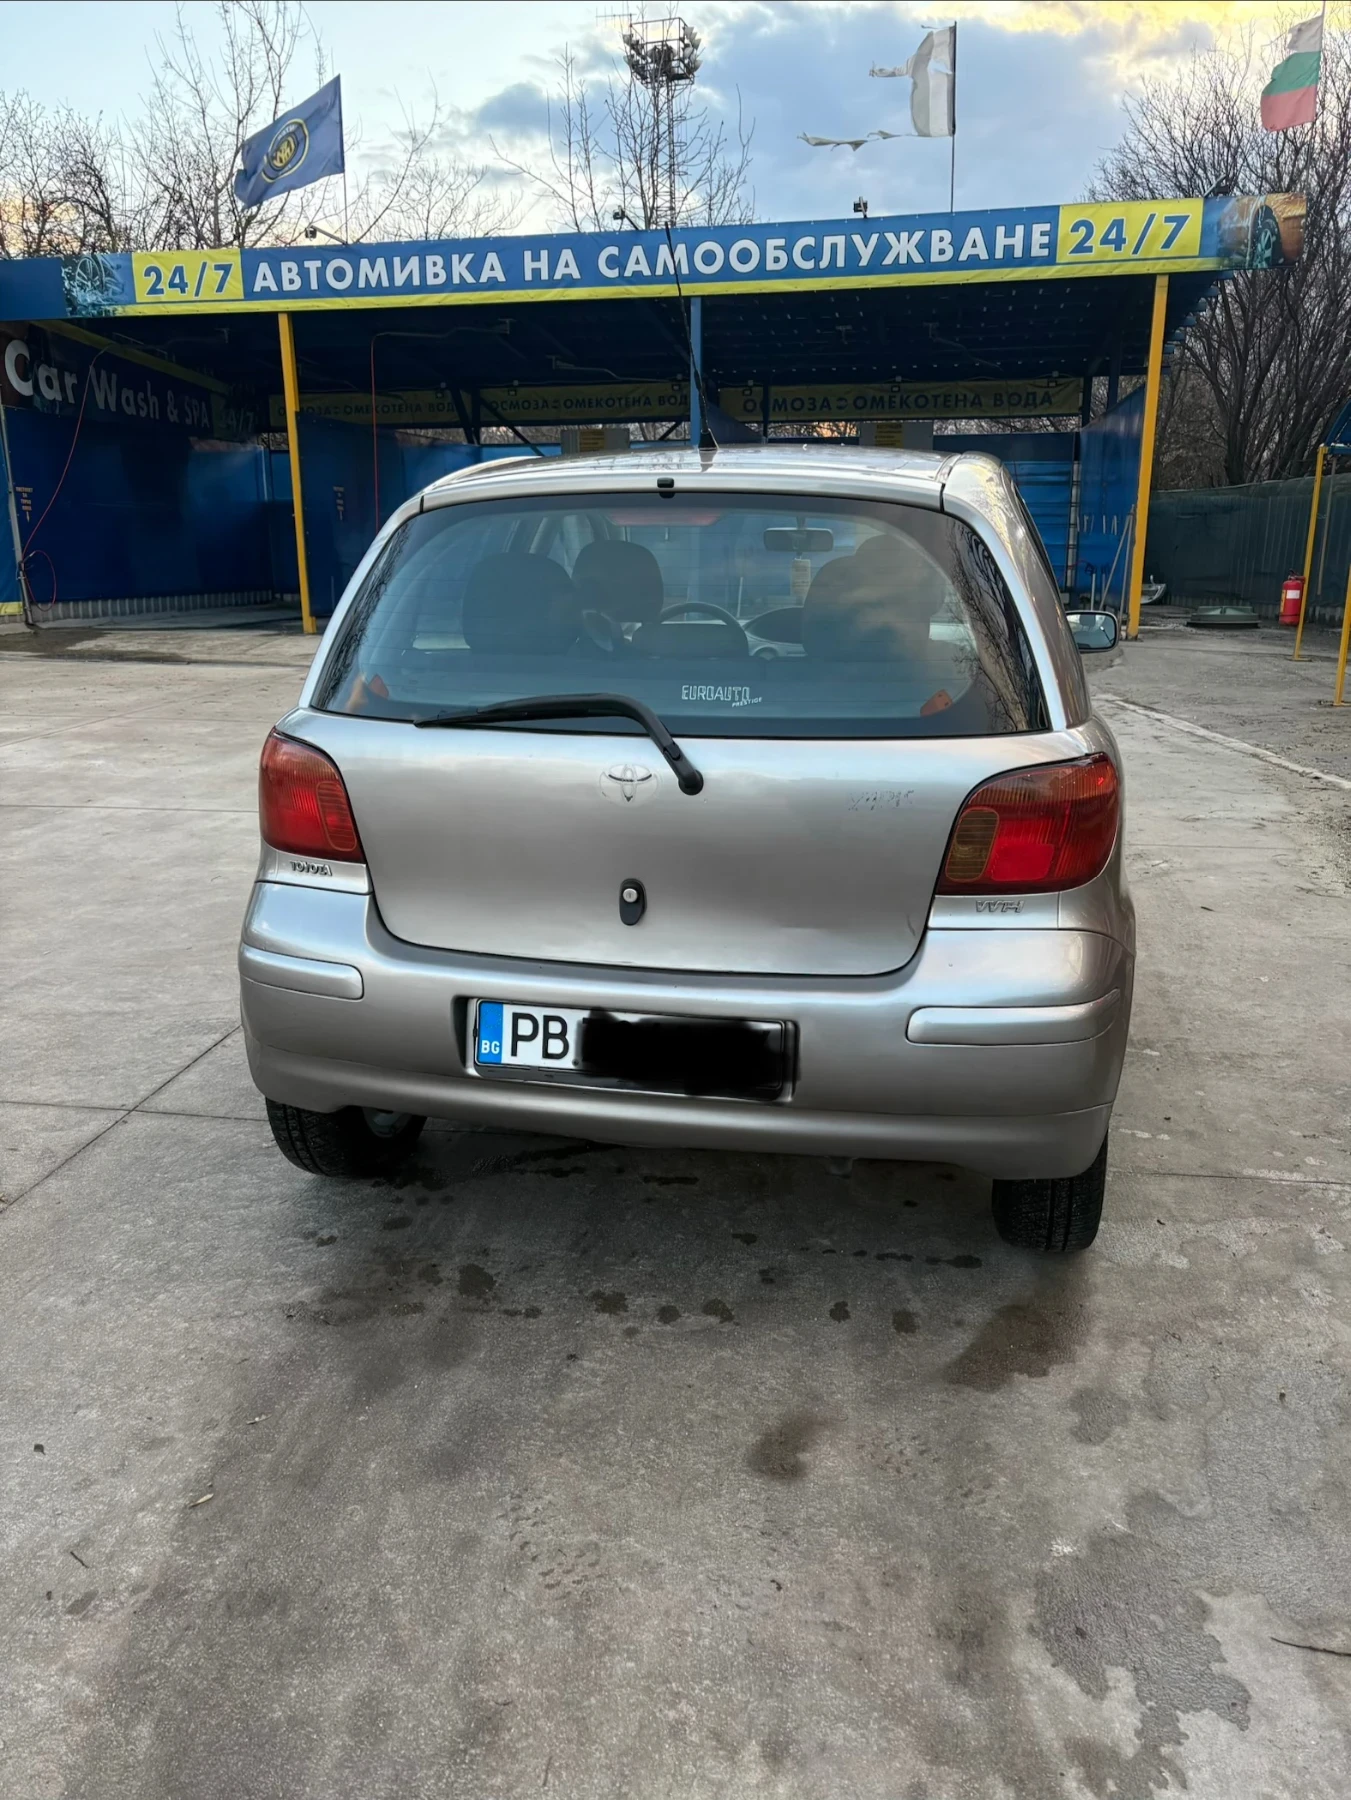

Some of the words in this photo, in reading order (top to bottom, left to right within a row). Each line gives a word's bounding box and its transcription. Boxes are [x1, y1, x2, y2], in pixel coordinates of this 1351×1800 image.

[143, 261, 234, 298] 24/7
[252, 252, 507, 293] АВТОМИВКА
[523, 248, 582, 282] НА
[597, 222, 1051, 279] САМООБСЛУЖВАНЕ
[1066, 212, 1191, 256] 24/7
[4, 339, 79, 405] Car
[89, 365, 160, 420] Wash
[166, 389, 181, 425] &
[184, 395, 212, 430] SPA
[428, 402, 456, 413] ВОД
[490, 399, 549, 411] ОСМОЗА
[563, 395, 652, 409] ОМЕКОТЕНА
[658, 394, 688, 407] ВОД
[853, 393, 983, 410] ОМЕКОТЕНА
[993, 390, 1053, 409] ВОДА
[681, 685, 750, 701] EUROAUTO
[290, 860, 333, 877] TOYOTA
[510, 1011, 570, 1061] PB
[481, 1039, 501, 1055] BG
